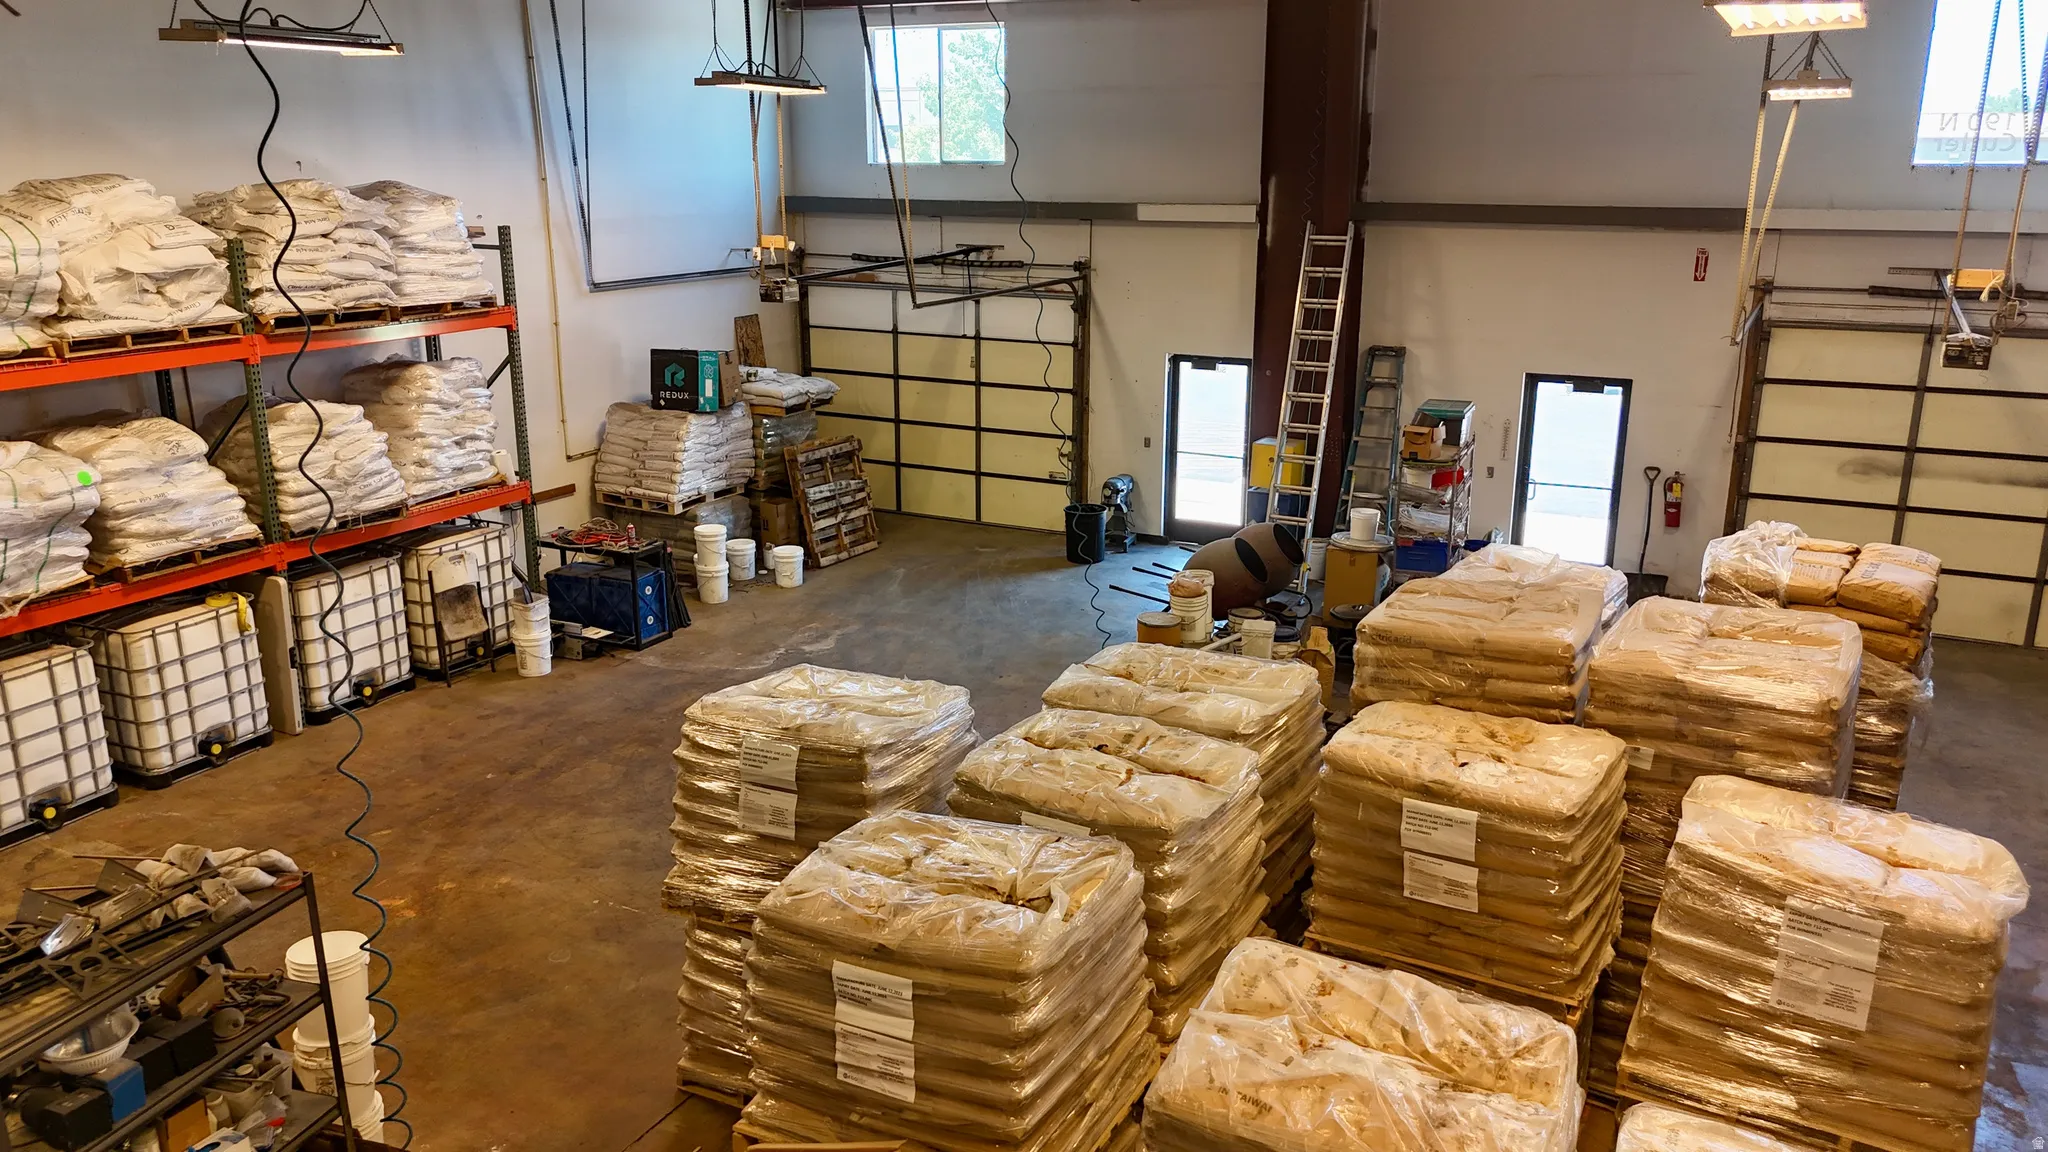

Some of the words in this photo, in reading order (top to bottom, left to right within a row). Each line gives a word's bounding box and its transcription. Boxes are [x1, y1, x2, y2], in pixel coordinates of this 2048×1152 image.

[660, 391, 689, 399] REDUX
[1371, 632, 1392, 643] citric
[1393, 635, 1412, 644] acid
[1217, 1086, 1229, 1096] IN
